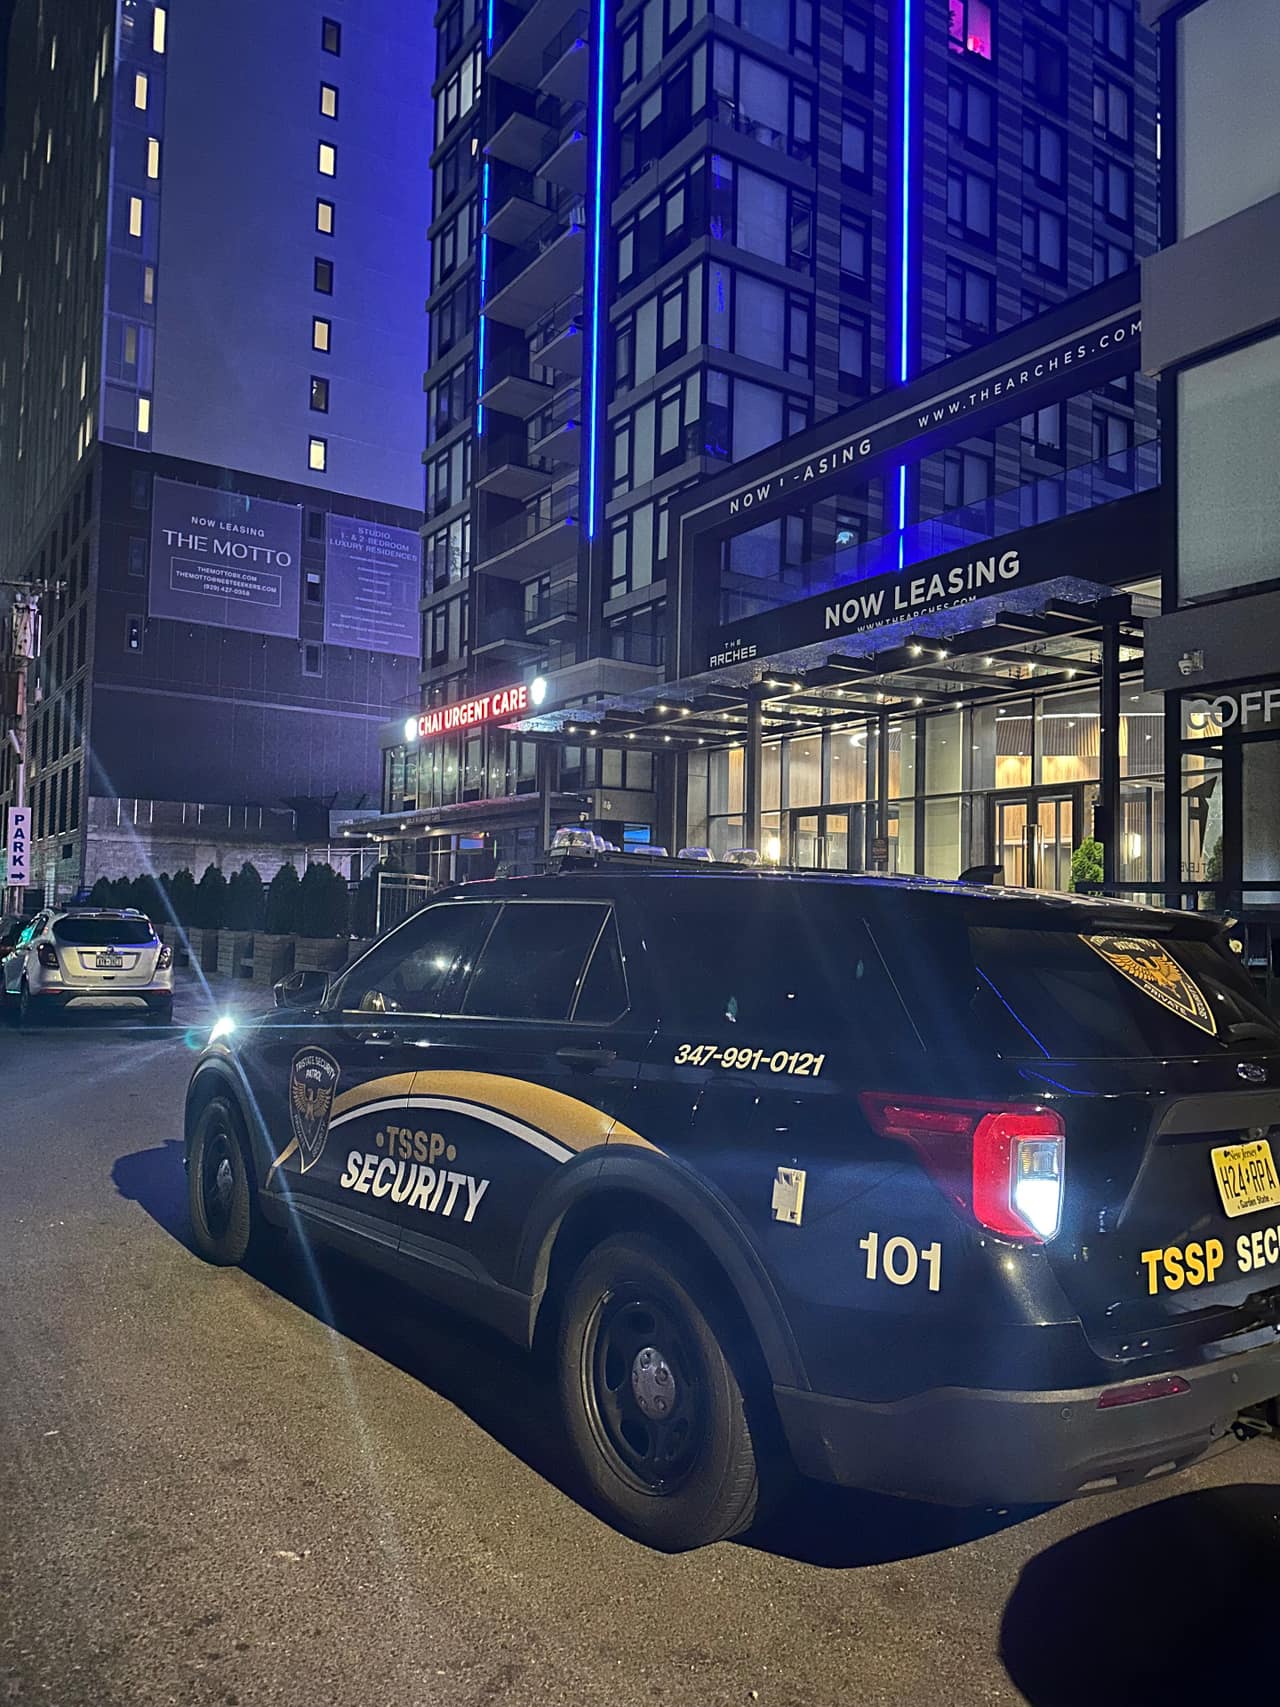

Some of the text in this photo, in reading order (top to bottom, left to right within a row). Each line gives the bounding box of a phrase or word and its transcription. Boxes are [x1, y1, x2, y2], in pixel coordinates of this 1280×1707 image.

[917, 320, 1142, 428] WWW.THEARCHES.COM
[730, 439, 871, 514] NOW ASING
[162, 529, 291, 567] THE MOTTO
[191, 516, 265, 537] NOW LEASING
[330, 538, 418, 561] LUXURY RESIDENCES
[825, 550, 1020, 630] NOW LEASING
[710, 644, 757, 668] ARCHES
[418, 685, 527, 736] CHAI URGENT CARE
[12, 814, 25, 867] PARK
[674, 1044, 825, 1077] 347-991-0121
[386, 1126, 445, 1164] TSSP
[340, 1150, 490, 1222] SECURITY
[859, 1232, 942, 1291] 101
[1141, 1225, 1280, 1295] TSSP SEC
